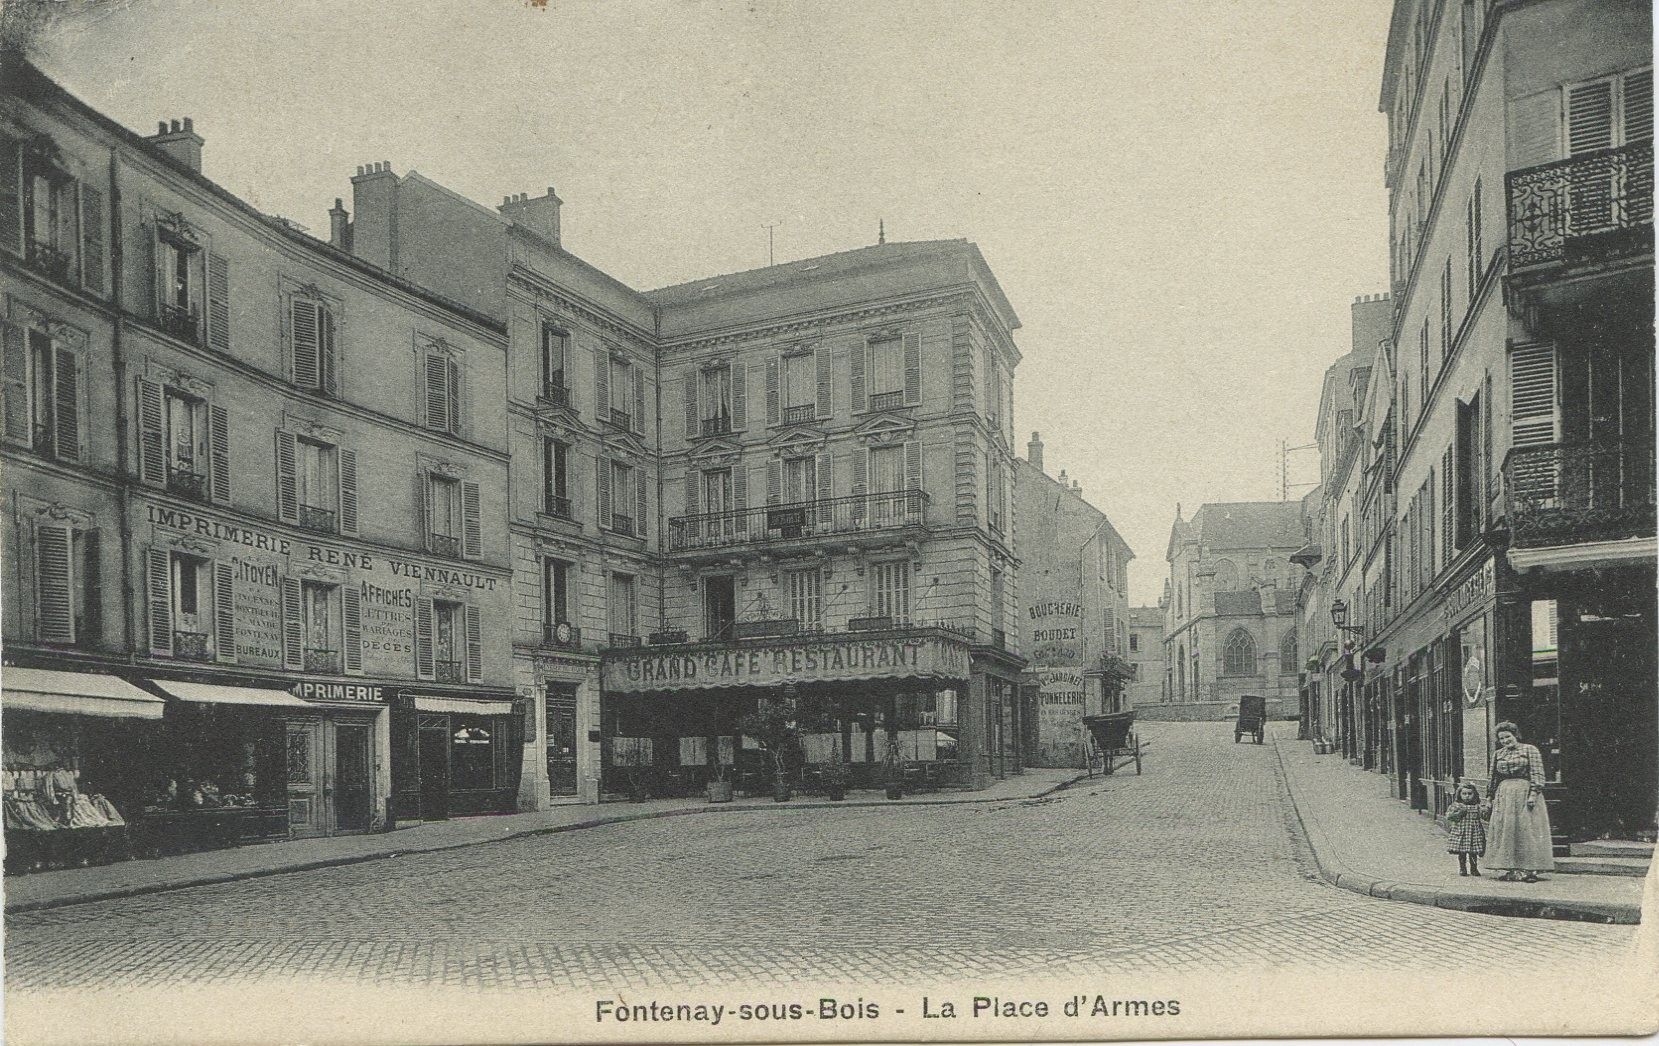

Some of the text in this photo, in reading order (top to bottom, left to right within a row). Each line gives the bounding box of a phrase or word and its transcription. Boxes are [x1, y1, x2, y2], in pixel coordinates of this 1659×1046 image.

[147, 505, 497, 592] IMPRIMERIE RENÉ VIENNAULT
[361, 580, 412, 608] AFFICHES
[1029, 602, 1081, 620] BOUCHERIE
[1033, 627, 1077, 641] BOUDET
[235, 644, 281, 659] BUREAUX
[626, 655, 698, 682] GRAND
[288, 682, 383, 701] MPRIMERIE
